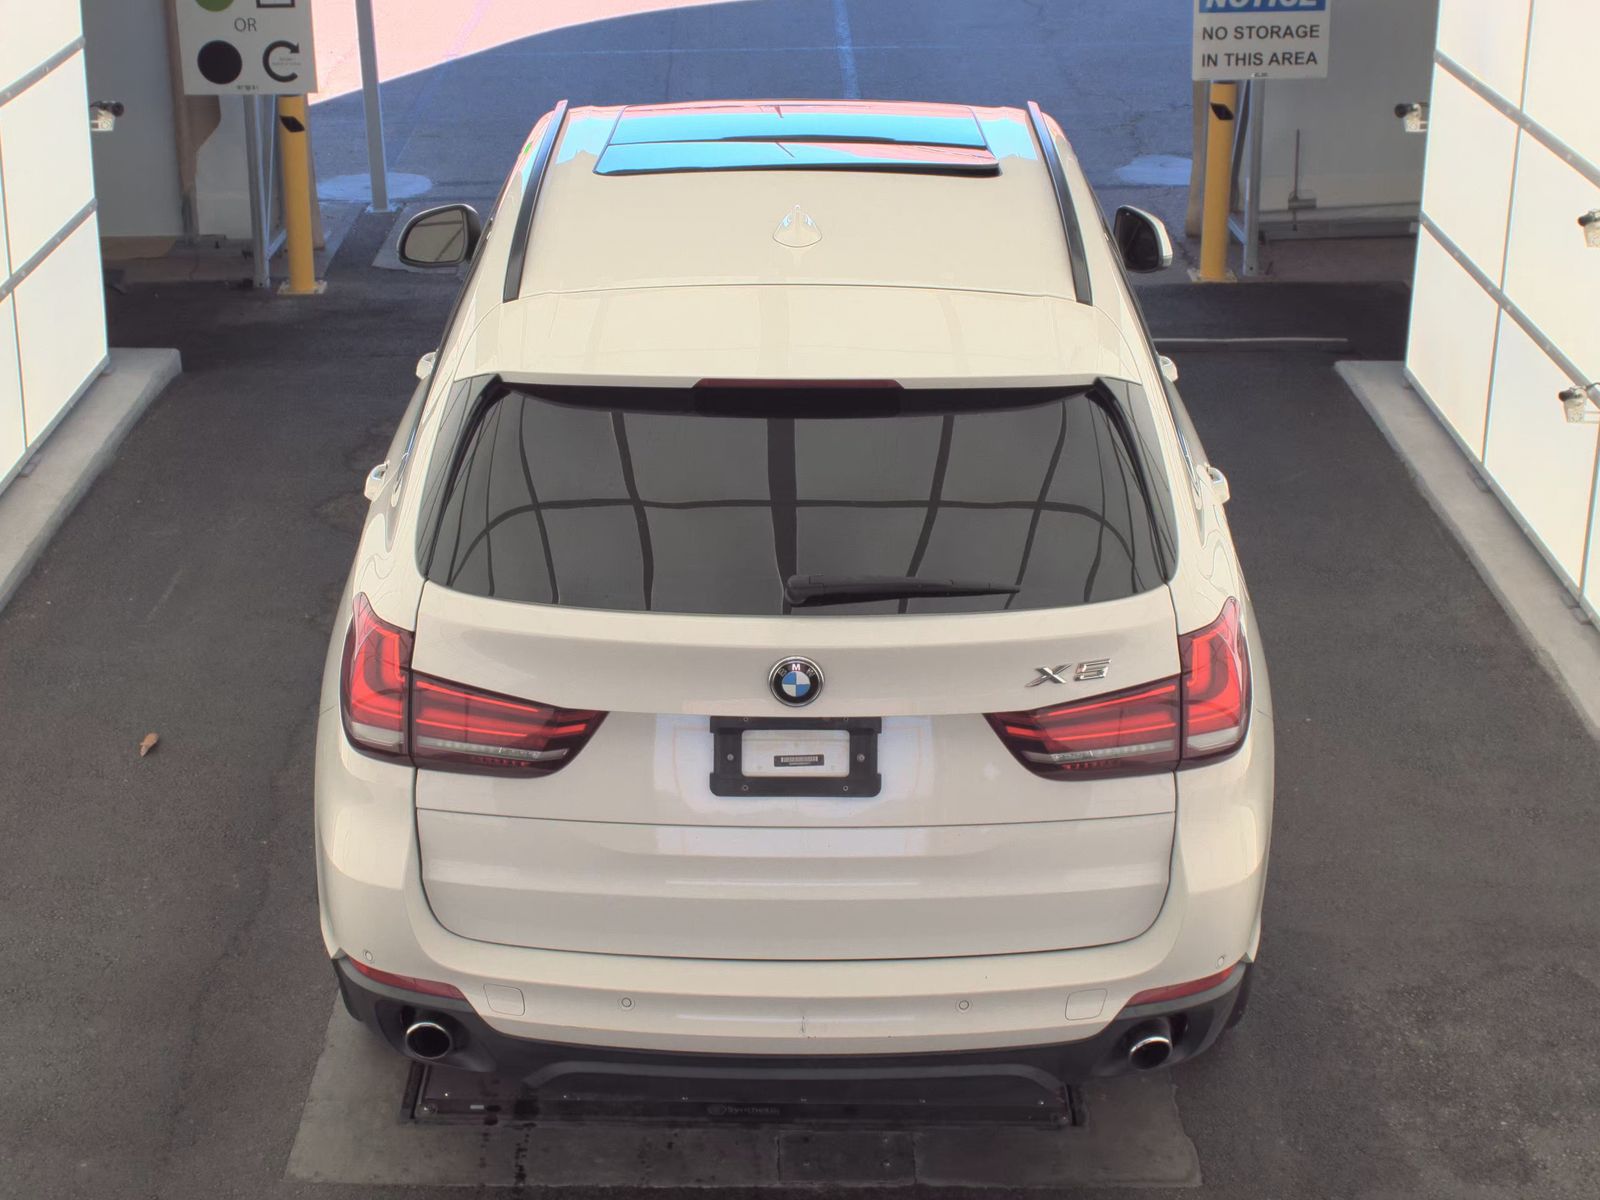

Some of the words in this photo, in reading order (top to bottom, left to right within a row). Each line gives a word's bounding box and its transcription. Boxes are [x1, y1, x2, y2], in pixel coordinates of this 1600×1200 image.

[234, 17, 257, 32] OR
[1202, 26, 1228, 41] NO
[1233, 24, 1320, 40] STORAGE
[1202, 53, 1218, 68] IN
[1224, 52, 1264, 67] THIS
[1268, 51, 1318, 66] AREA
[778, 663, 816, 678] BMW
[1024, 658, 1112, 688] X5
